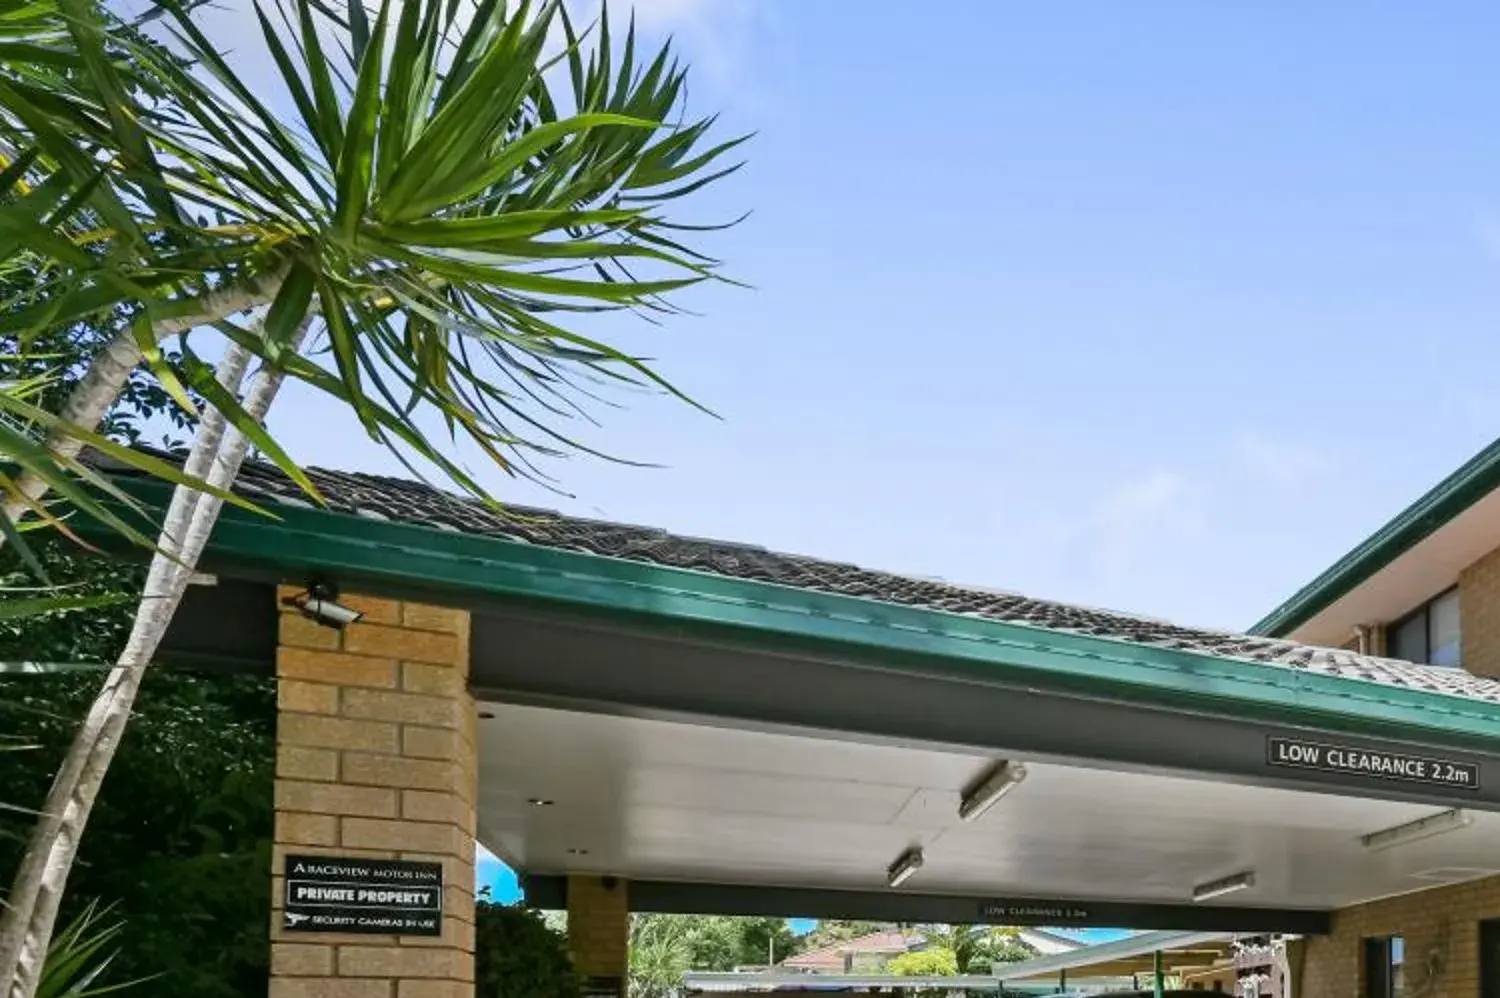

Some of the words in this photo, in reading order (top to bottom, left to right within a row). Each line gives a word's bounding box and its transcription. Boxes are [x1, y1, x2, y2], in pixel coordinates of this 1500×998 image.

[1279, 743, 1319, 764] LOW
[1327, 749, 1425, 778] CLEARANCE
[1432, 763, 1469, 783] 2.2m
[293, 863, 305, 873] A
[373, 869, 413, 879] MOTOR
[415, 871, 437, 880] INN
[297, 887, 354, 901] PRIVATE
[357, 889, 430, 904] PROPERTY
[312, 915, 355, 925] SECURITY
[358, 917, 402, 927] CAMERAS
[418, 920, 435, 929] USE
